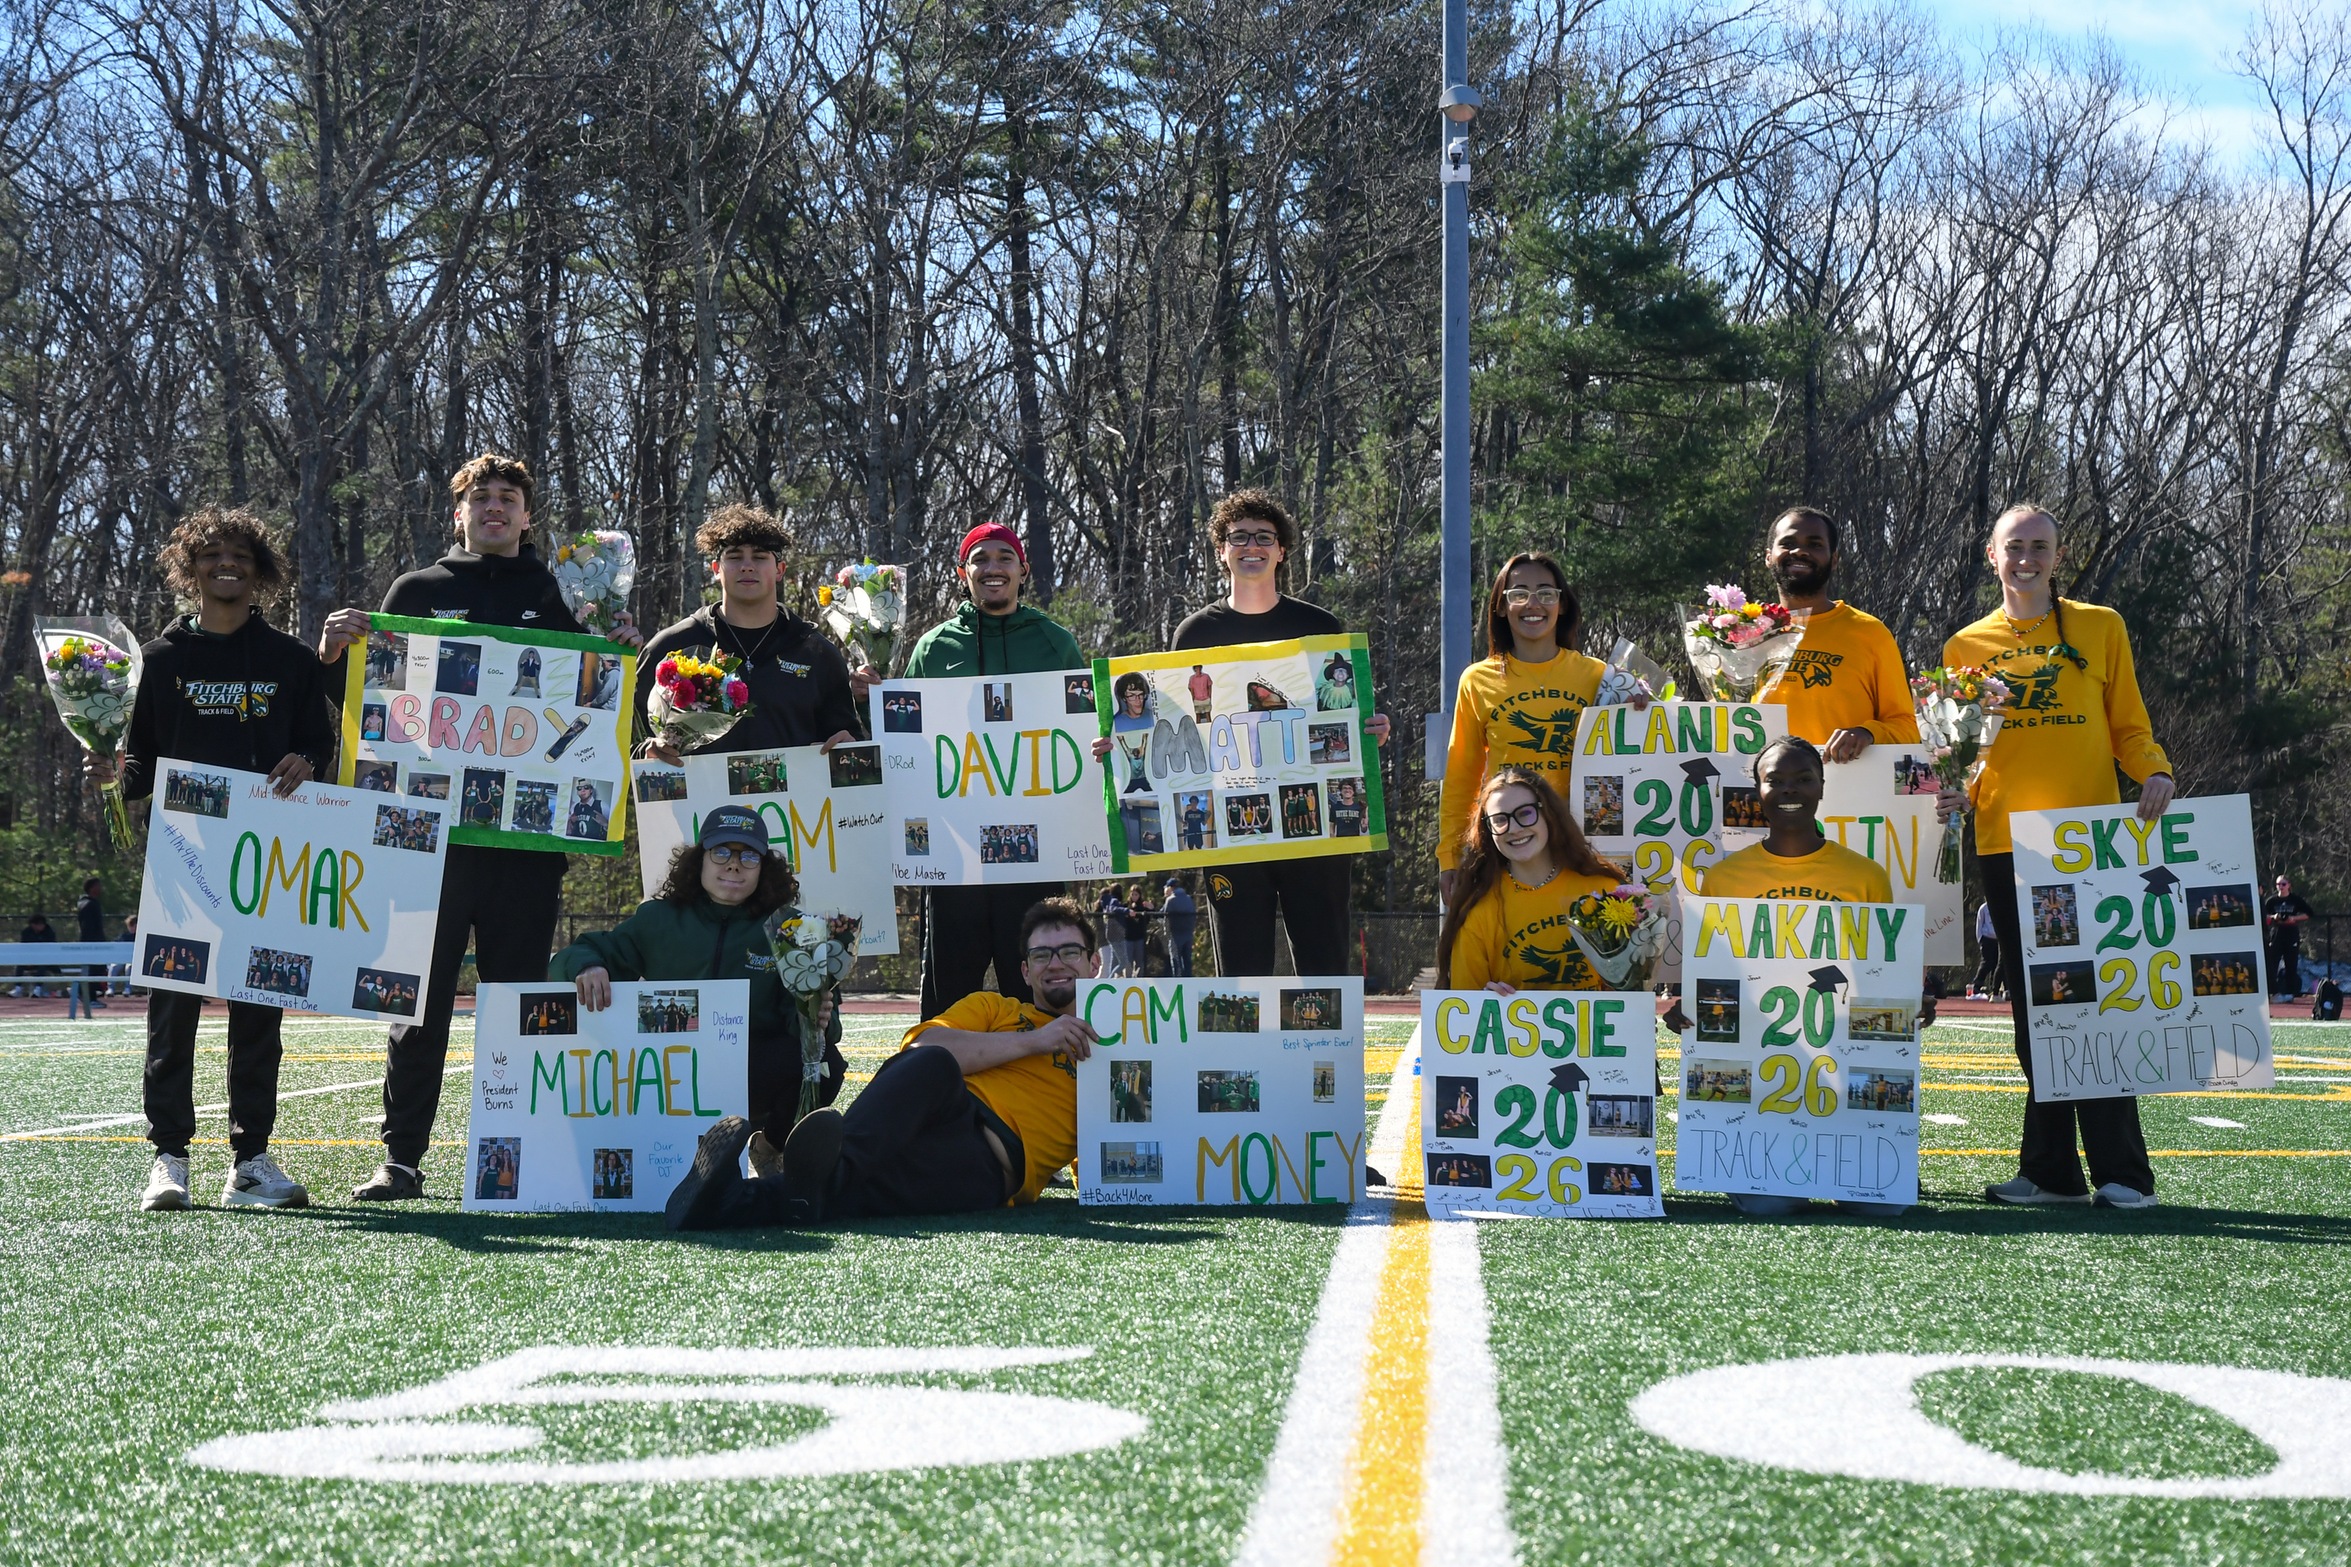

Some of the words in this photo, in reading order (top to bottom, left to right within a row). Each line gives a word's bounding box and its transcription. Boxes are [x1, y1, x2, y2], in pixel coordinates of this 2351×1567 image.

[195, 694, 244, 705] STATE
[2027, 718, 2037, 726] &
[2041, 714, 2086, 726] FIELD
[386, 694, 592, 763] BRADY
[1151, 708, 1306, 779] MATT
[1582, 703, 1767, 756] ALANIS
[936, 729, 1083, 799] DAVID
[1547, 761, 1557, 770] &
[316, 792, 351, 807] Warrior
[1633, 779, 1713, 837] 20
[164, 824, 223, 909] #Thx4TheDiscounts
[1068, 845, 1088, 859] Last
[1074, 861, 1094, 875] Fast
[1635, 839, 1716, 895] 26
[2052, 812, 2199, 874] SKYE
[229, 831, 370, 933] OMAR
[915, 865, 946, 880] Master
[1694, 903, 1907, 962] MAKANY
[2094, 892, 2176, 954] 20
[230, 986, 255, 1001] Last
[278, 995, 299, 1009] Fast
[302, 999, 318, 1011] One
[2099, 950, 2182, 1016] 26
[713, 1012, 744, 1025] Distance
[718, 1028, 738, 1045] King
[1084, 983, 1188, 1046] CAM
[1435, 997, 1627, 1058] CASSIE
[1759, 986, 1836, 1049] 20
[492, 1052, 507, 1065] We
[1282, 1038, 1299, 1049] Best
[1303, 1038, 1331, 1050] Sprinter
[1334, 1037, 1353, 1047] Ever!
[2037, 1031, 2131, 1088] TRACK
[2135, 1030, 2165, 1084] &
[2164, 1024, 2260, 1081] FIELD
[482, 1081, 518, 1096] President
[485, 1097, 513, 1110] Burns
[530, 1045, 722, 1117] MICHAEL
[1758, 1054, 1838, 1117] 26
[1494, 1084, 1578, 1149] 20
[654, 1142, 673, 1151] Our
[658, 1166, 671, 1177] DJ
[1196, 1131, 1362, 1204] MONEY
[1690, 1129, 1780, 1181] TRACK
[1785, 1133, 1812, 1185] &
[1815, 1133, 1900, 1190] FIELD
[533, 1200, 550, 1210] Last
[572, 1201, 589, 1211] Fast
[1082, 1188, 1153, 1203] #Back4More
[1495, 1154, 1582, 1205] 26
